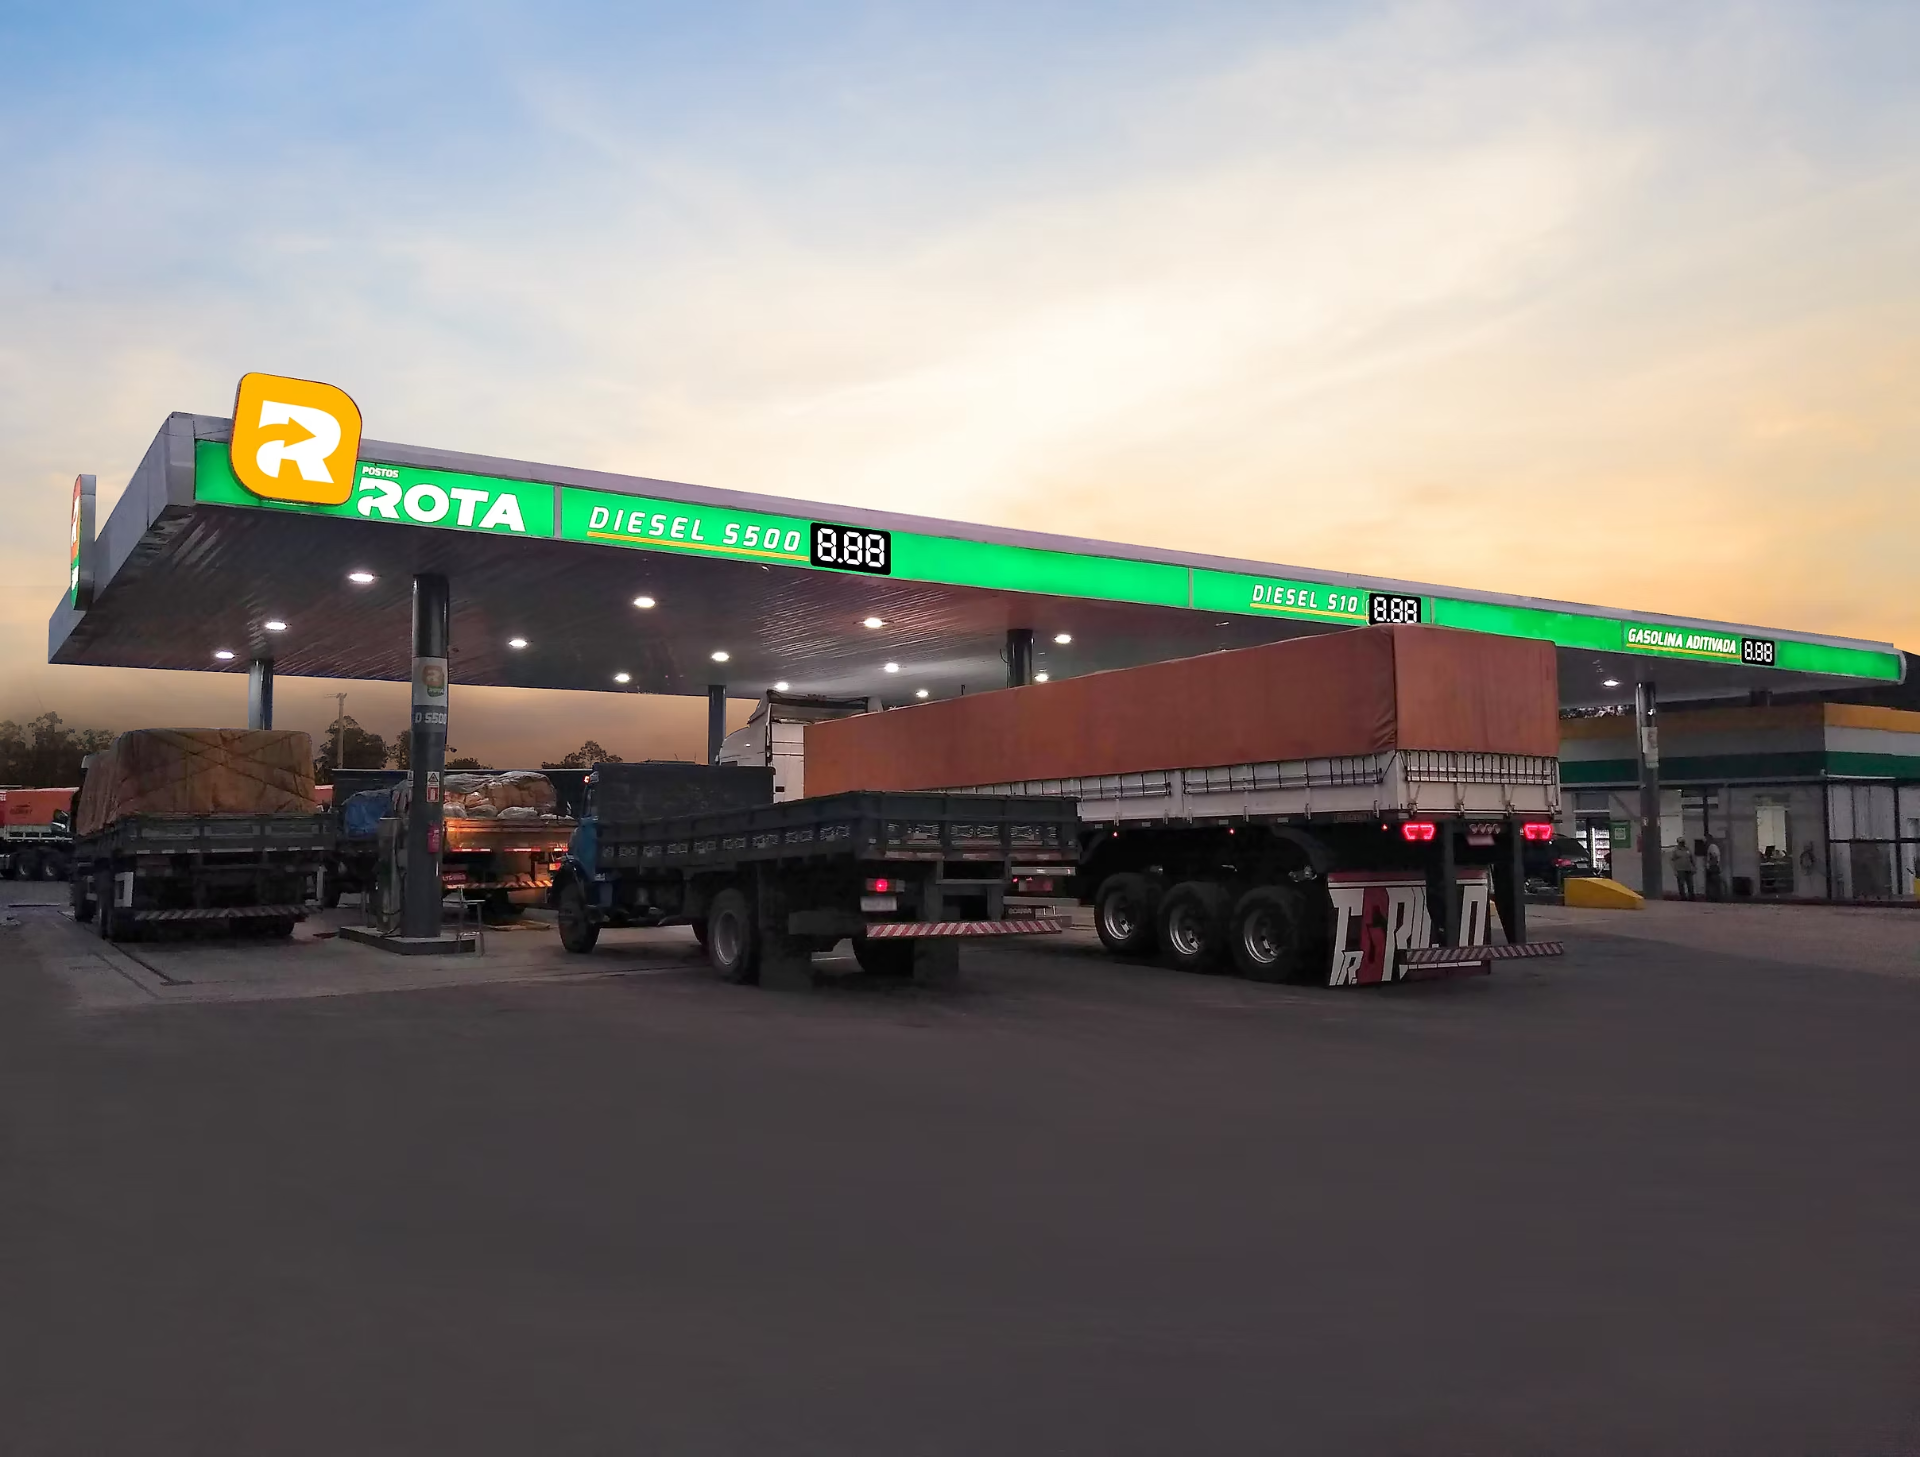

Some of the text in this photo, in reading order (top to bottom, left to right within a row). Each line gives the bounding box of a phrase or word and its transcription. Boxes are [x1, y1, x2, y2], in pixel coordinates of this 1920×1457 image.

[256, 400, 341, 483] R
[362, 466, 399, 478] POSTOS
[357, 477, 526, 532] ROTA
[588, 506, 801, 552] DIESEL S500
[817, 528, 885, 568] 8.88
[1252, 584, 1358, 612] DIESEL S10
[1373, 596, 1417, 623] 8.88
[1628, 628, 1736, 654] GASOLINA ADITIVADA
[1744, 640, 1773, 662] 8.88
